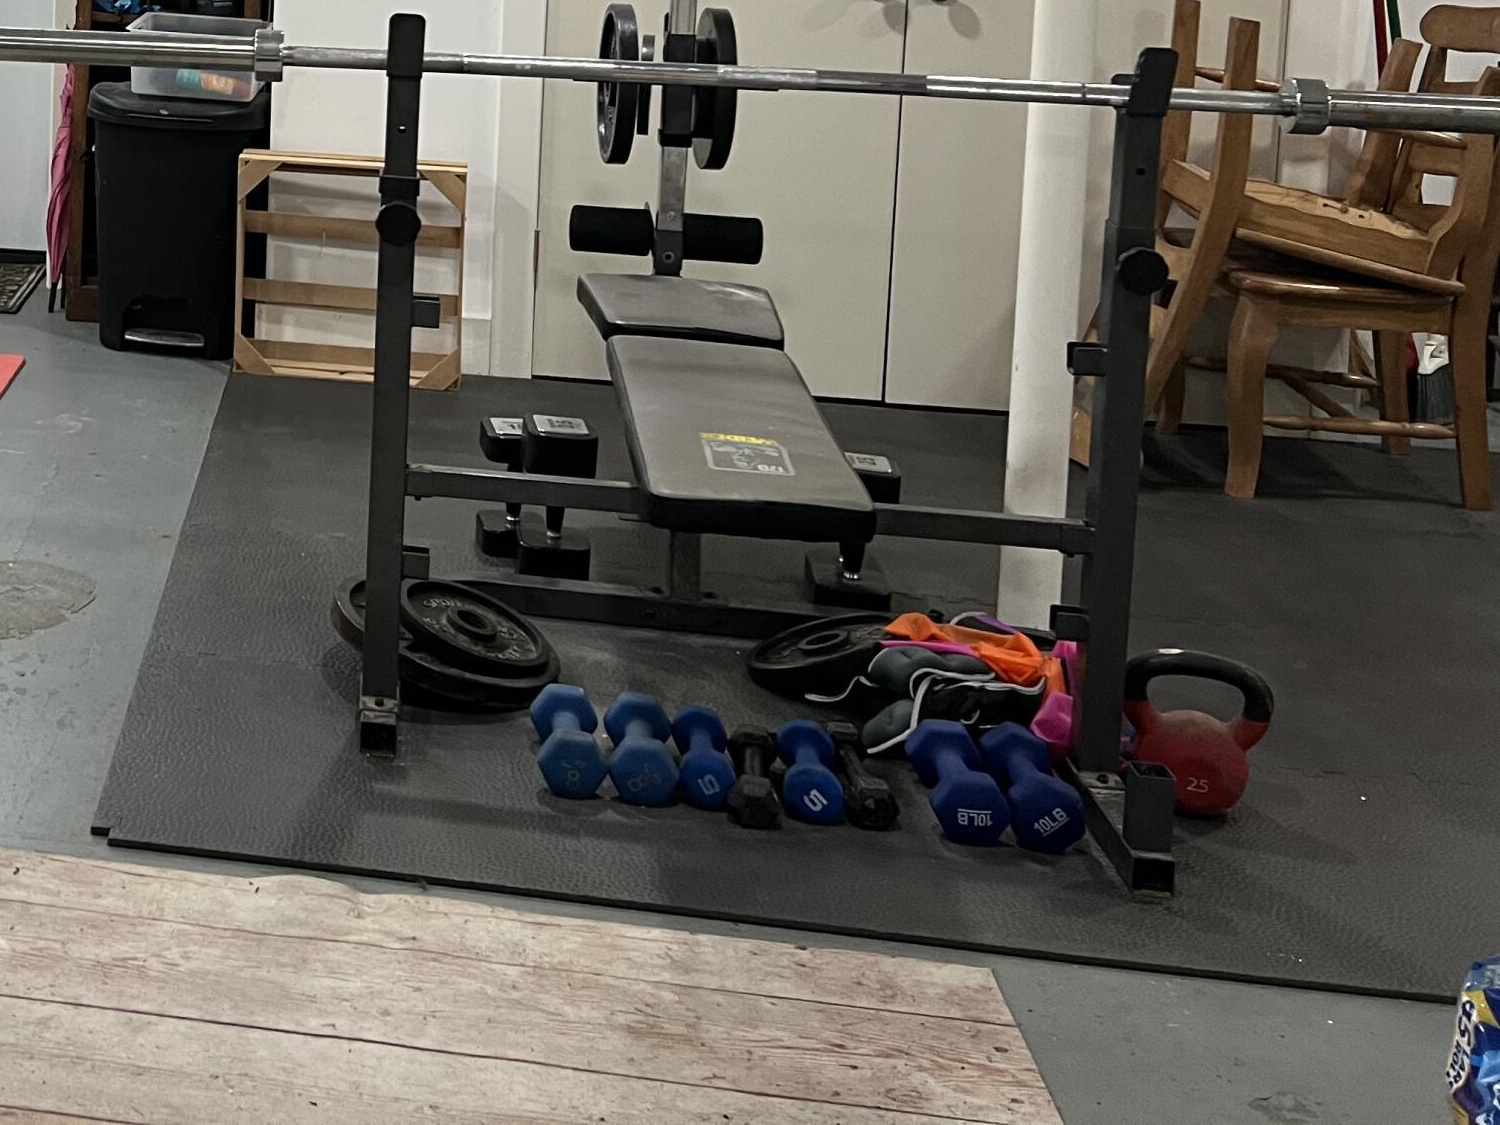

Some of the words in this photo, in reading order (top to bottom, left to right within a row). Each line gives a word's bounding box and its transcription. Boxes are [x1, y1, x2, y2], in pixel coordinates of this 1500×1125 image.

[697, 773, 721, 796] 5
[1185, 777, 1210, 793] 25
[802, 788, 829, 813] 5
[957, 810, 994, 827] 10LB
[1033, 806, 1068, 835] 10LB
